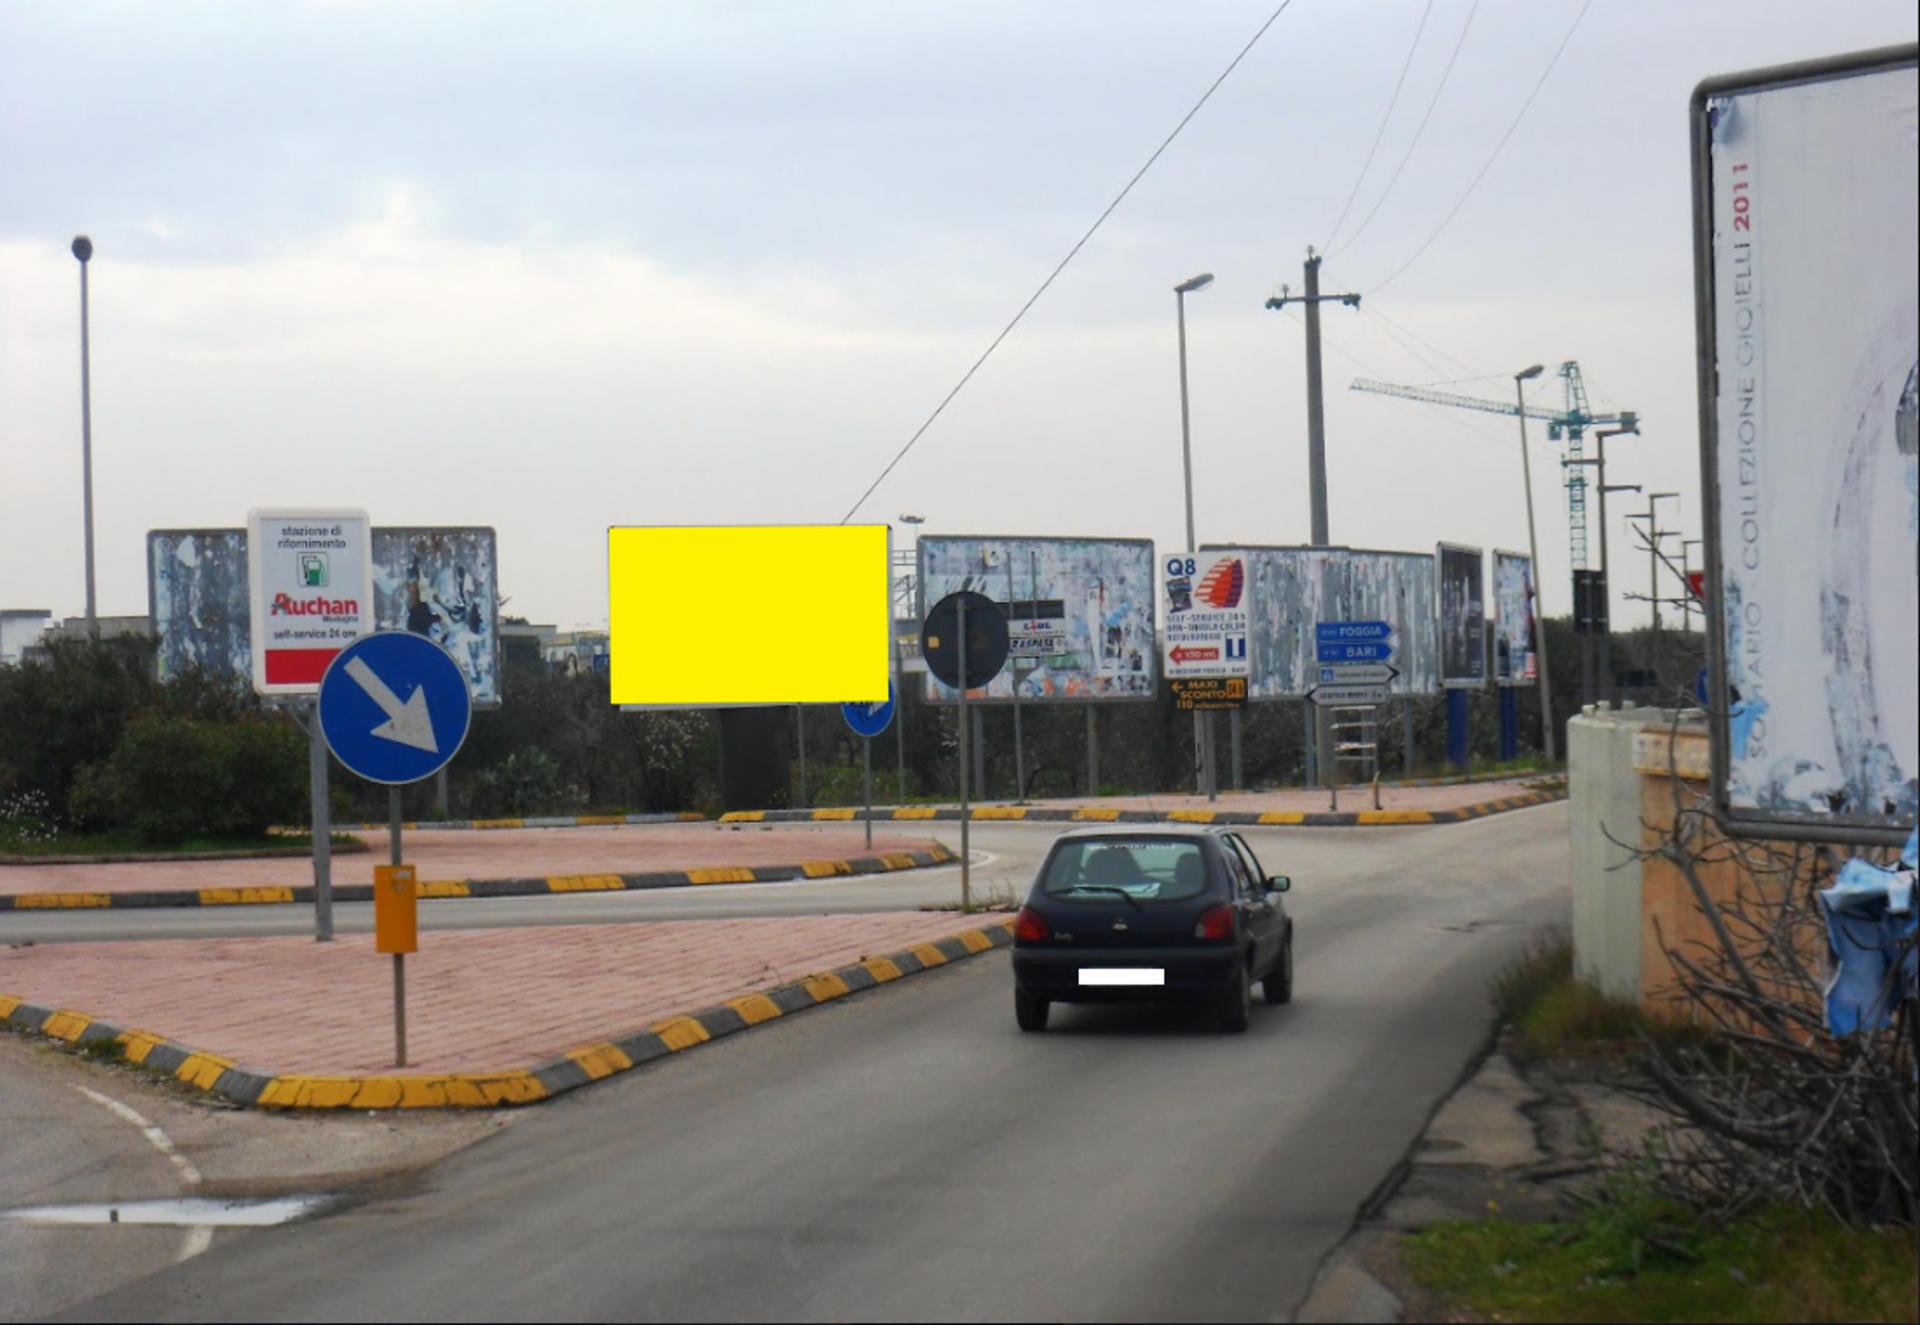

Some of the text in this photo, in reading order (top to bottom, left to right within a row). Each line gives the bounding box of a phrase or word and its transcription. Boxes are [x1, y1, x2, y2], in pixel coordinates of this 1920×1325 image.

[1732, 163, 1750, 231] 2011
[1734, 243, 1753, 367] GIOIELLI
[1738, 379, 1759, 570] COLLEZIONE
[281, 525, 342, 536] stazione di
[277, 538, 346, 549] rifornimento
[1167, 558, 1196, 576] Q8
[271, 592, 358, 616] Auchan
[274, 628, 357, 640] self-service 24 ore
[1340, 626, 1382, 637] FOGGIA
[1346, 646, 1377, 657] BARI
[1188, 681, 1217, 689] MAXI
[1180, 690, 1225, 698] SCONTO
